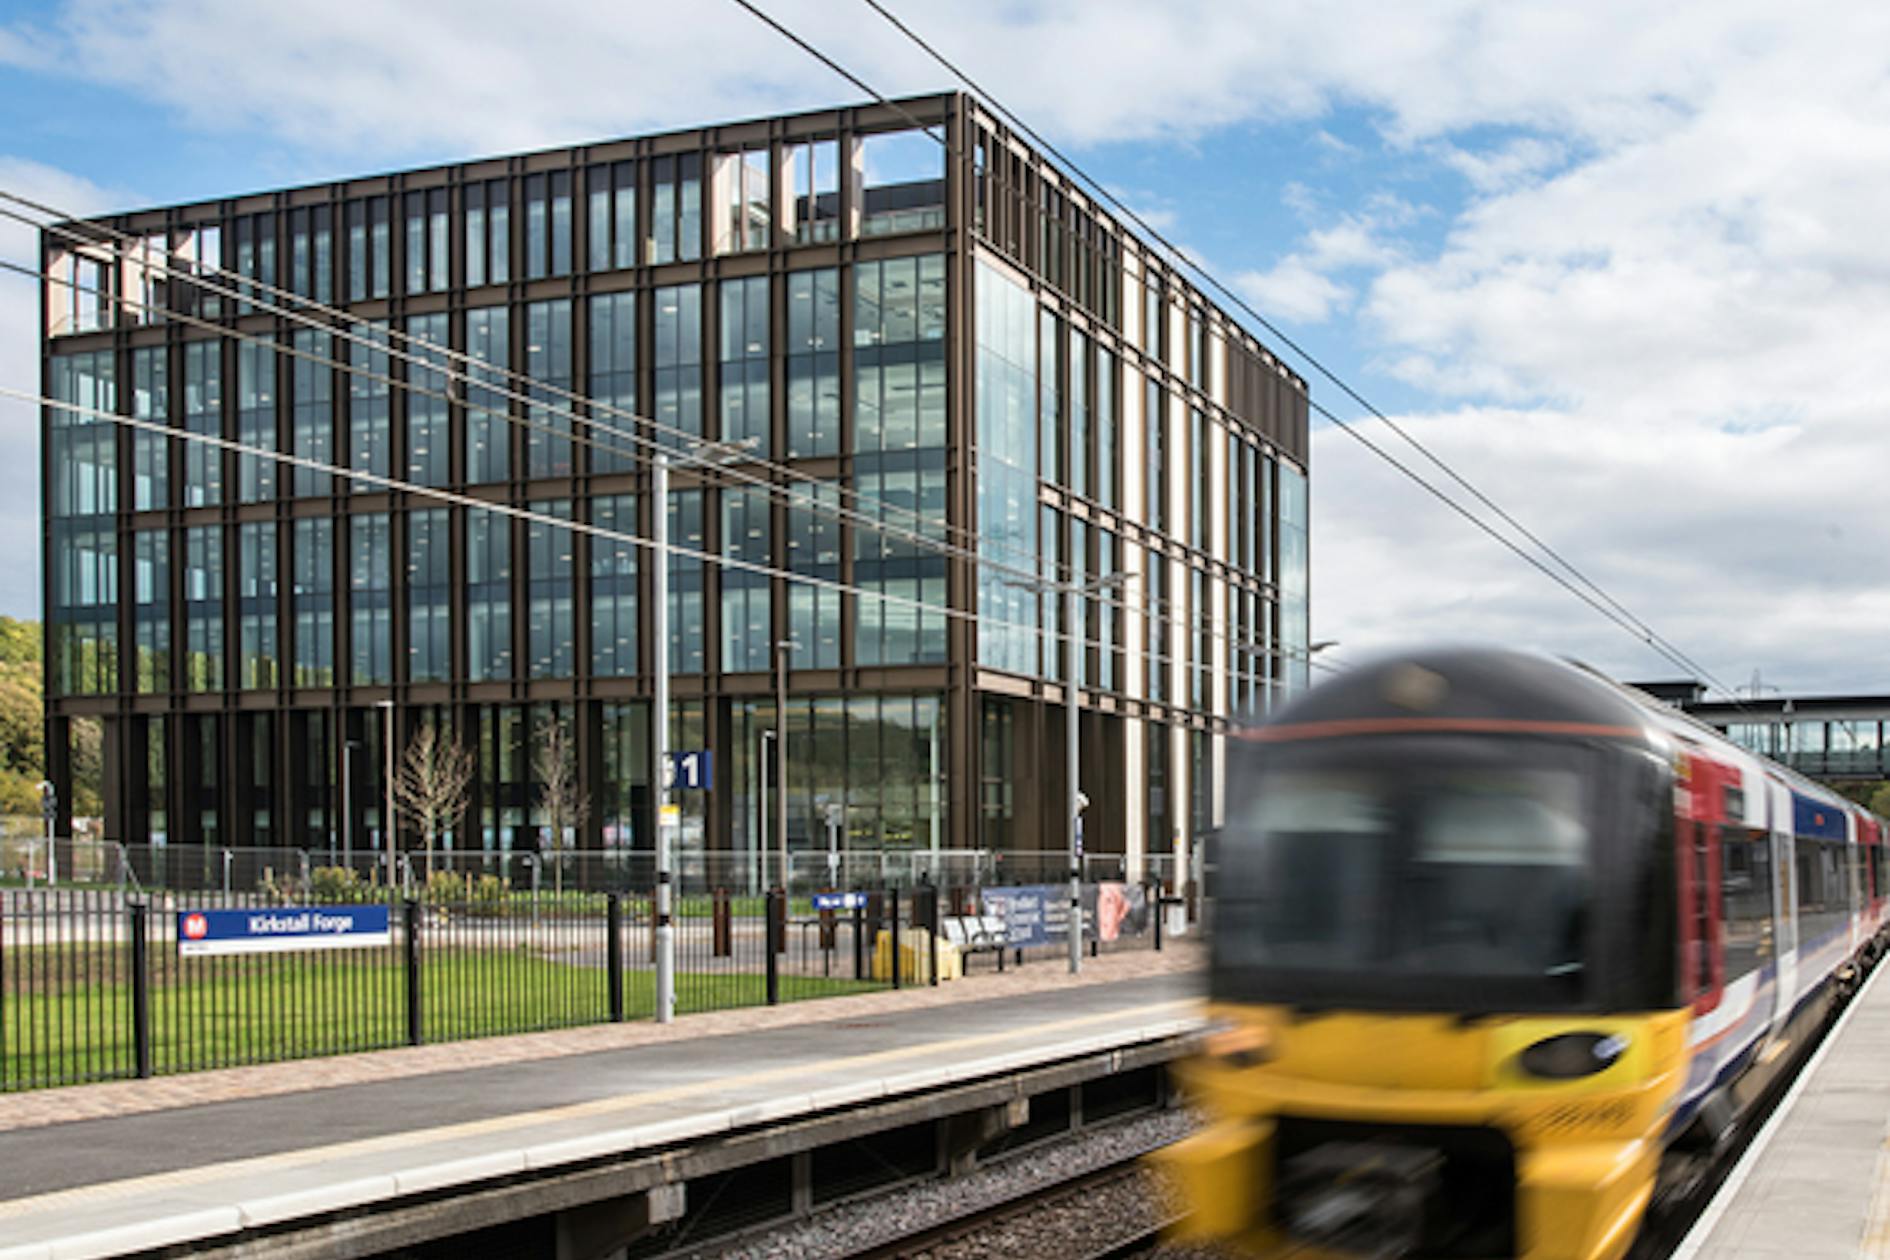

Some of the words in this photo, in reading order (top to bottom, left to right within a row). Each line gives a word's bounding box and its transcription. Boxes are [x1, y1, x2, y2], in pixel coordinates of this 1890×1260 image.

[681, 753, 699, 787] 1
[249, 913, 310, 933] Kirkstall
[313, 914, 354, 933] Forge
